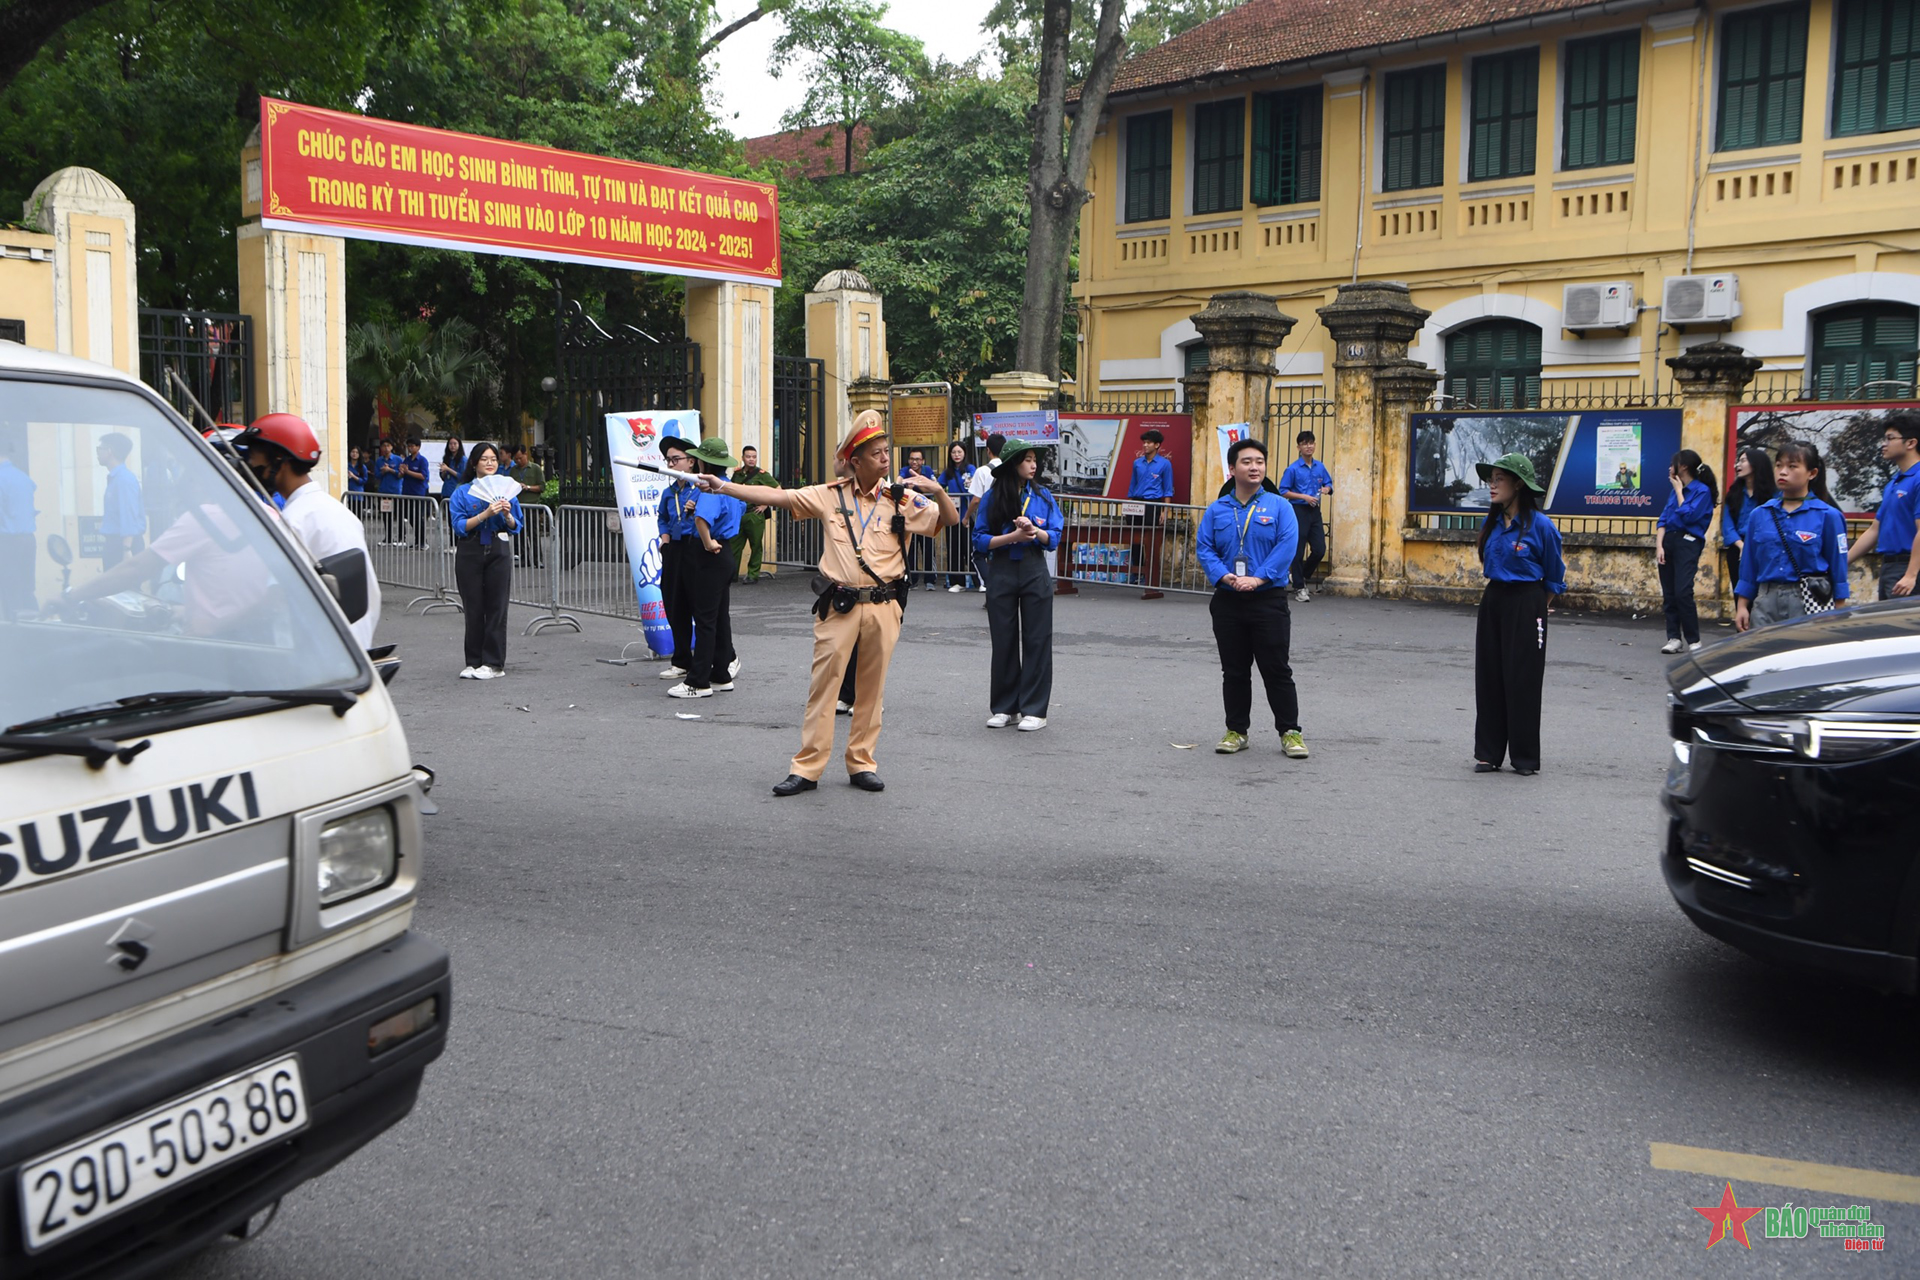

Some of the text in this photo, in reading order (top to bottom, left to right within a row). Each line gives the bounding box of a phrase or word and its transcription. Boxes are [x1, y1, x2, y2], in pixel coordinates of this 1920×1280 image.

[298, 128, 759, 223] CHÚC CÁC EM HỌC SINH BÌNH TĨNH, TỰ TIN VÀ ĐẠT KẾT QUẢ CAO
[307, 175, 367, 210] TRONG
[371, 181, 393, 213] KỲ
[398, 188, 425, 217] THI
[428, 187, 480, 224] TUYỂN
[484, 200, 522, 229] SINH
[525, 203, 555, 233] VÀO
[558, 207, 586, 237] LỚP
[589, 215, 607, 240] 10
[610, 215, 643, 244] NĂM
[645, 222, 673, 252] HỌC
[676, 227, 707, 253] 2024
[719, 233, 753, 259] 2025!
[638, 485, 660, 501] TIẾP
[1584, 495, 1652, 507] TRUNG THỰC
[34, 1070, 297, 1236] 29D-503.86
